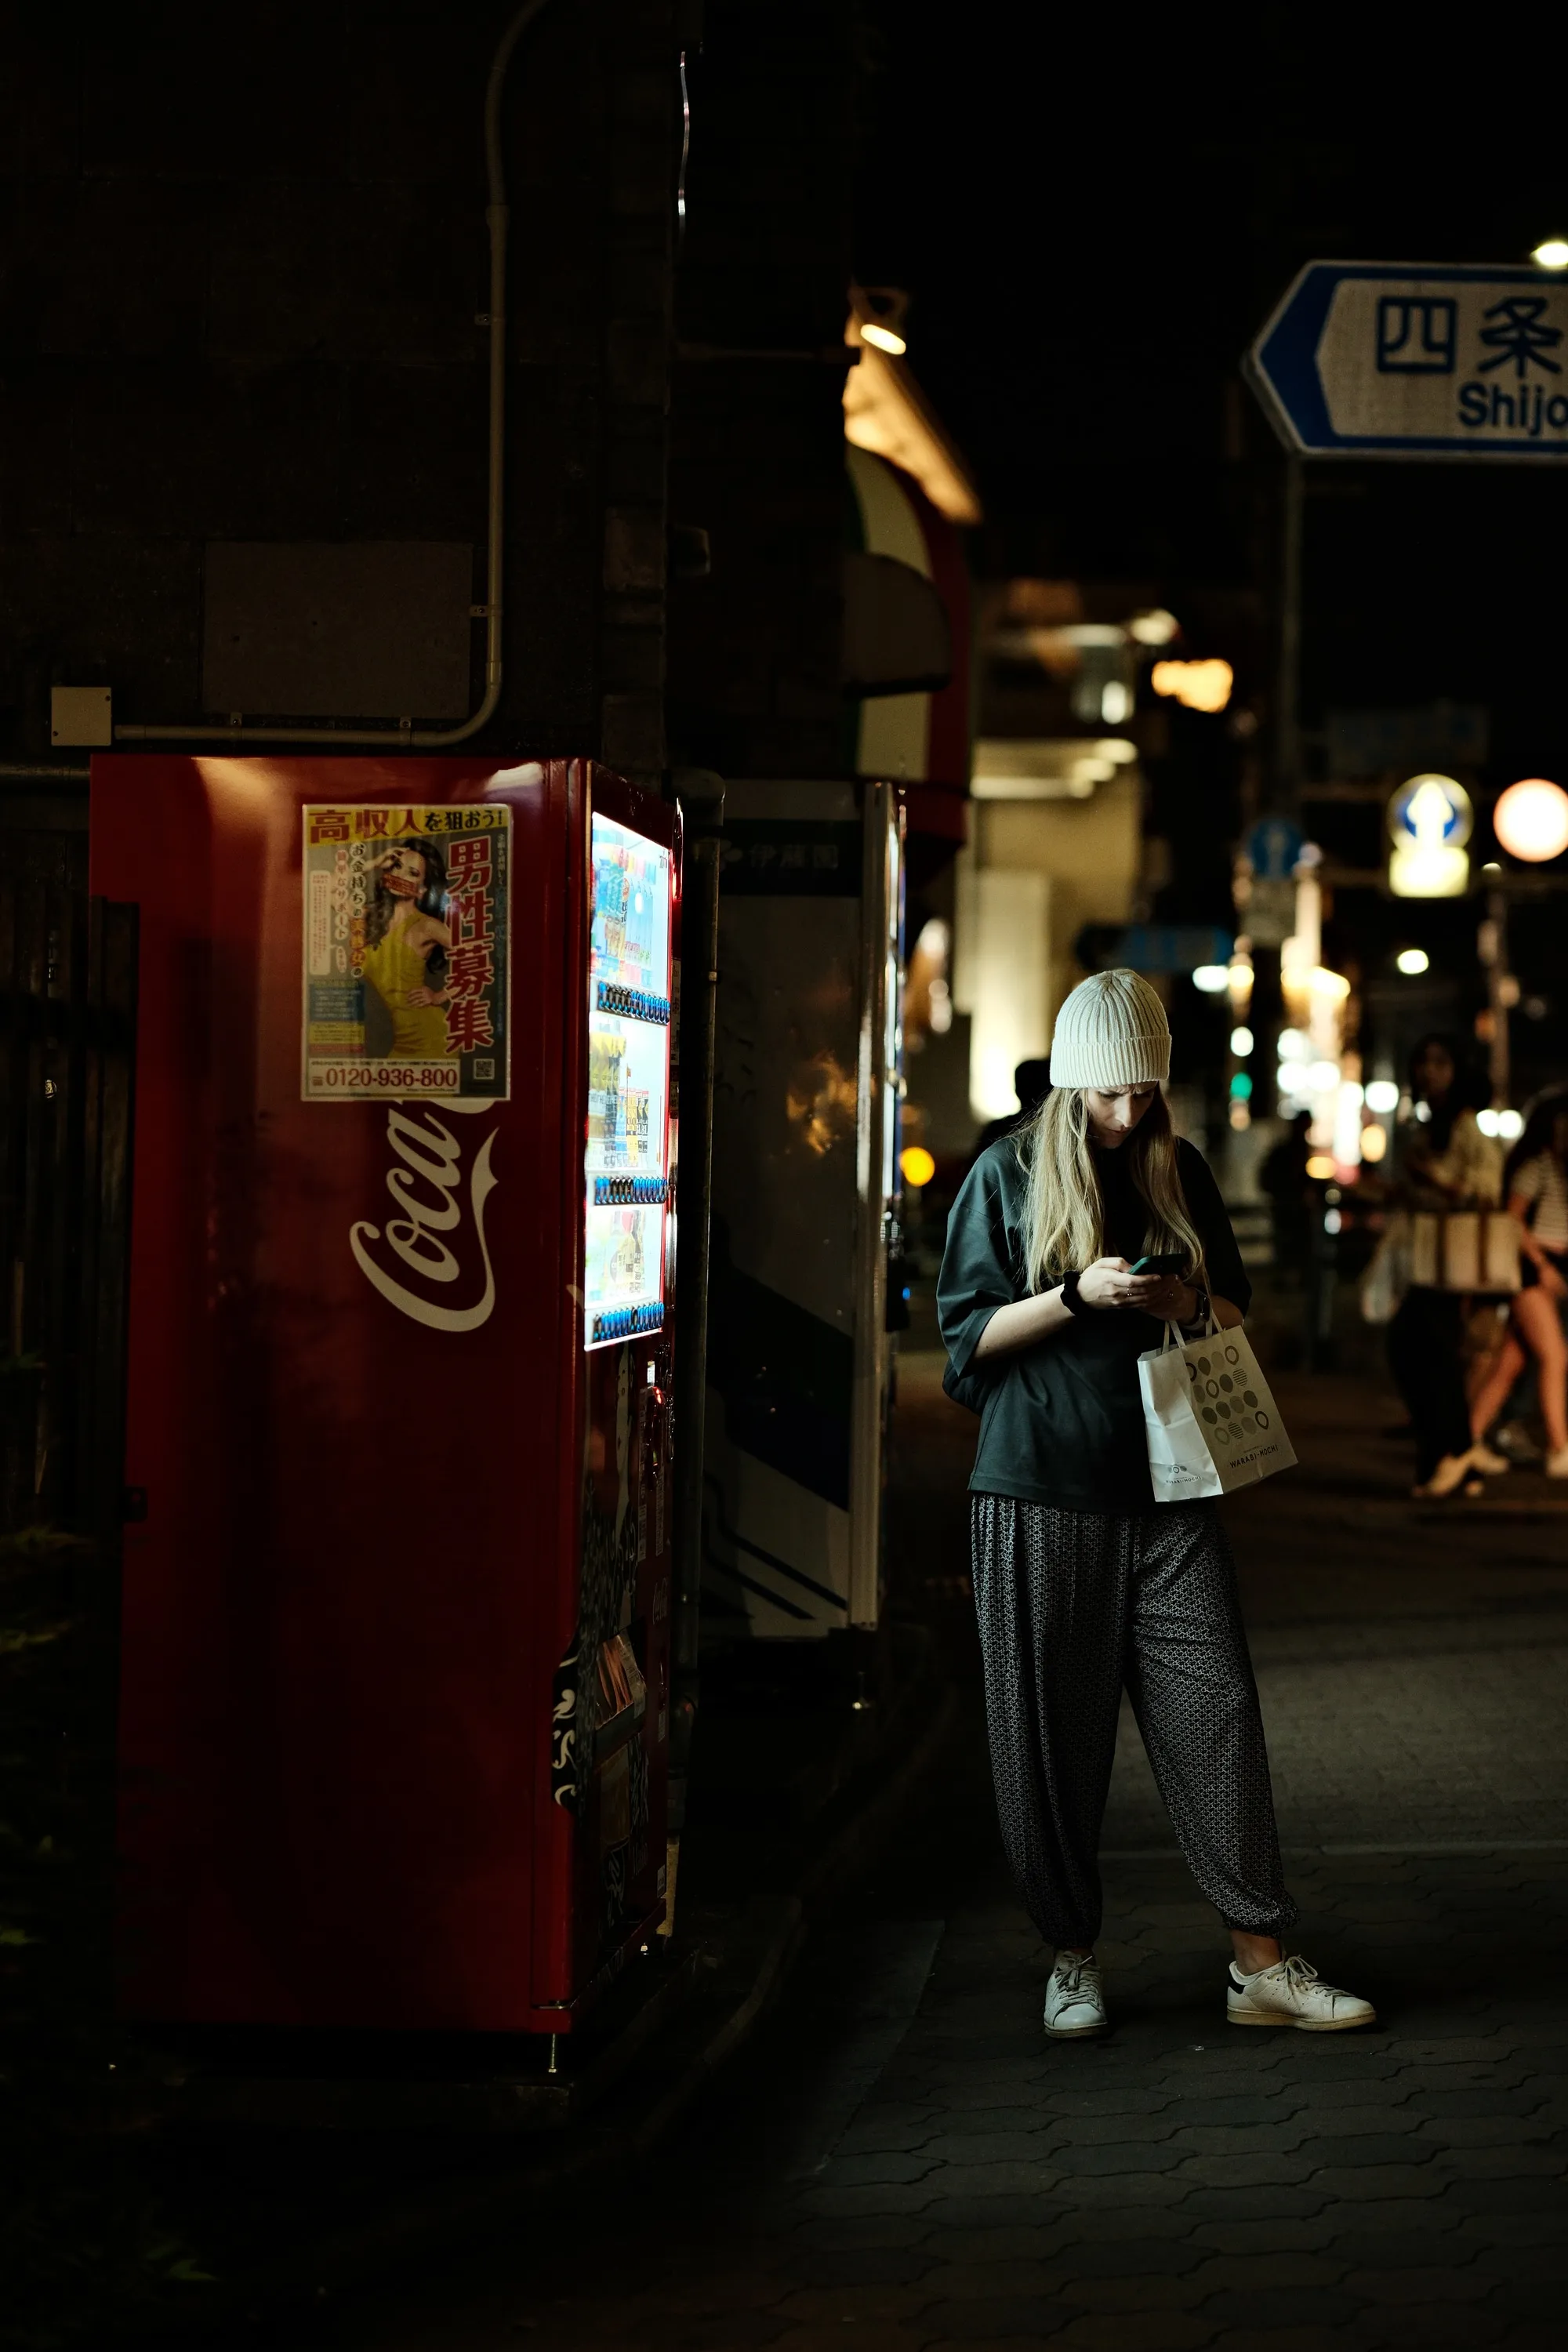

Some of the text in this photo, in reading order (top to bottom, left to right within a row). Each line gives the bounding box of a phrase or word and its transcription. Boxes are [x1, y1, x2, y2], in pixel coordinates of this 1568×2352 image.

[1377, 298, 1563, 377] 四条
[1459, 383, 1568, 435] Shijo
[445, 835, 495, 1054] 男性募集
[325, 1068, 458, 1087] 0120-936-800
[1229, 1444, 1279, 1468] WARABI-MOCHI
